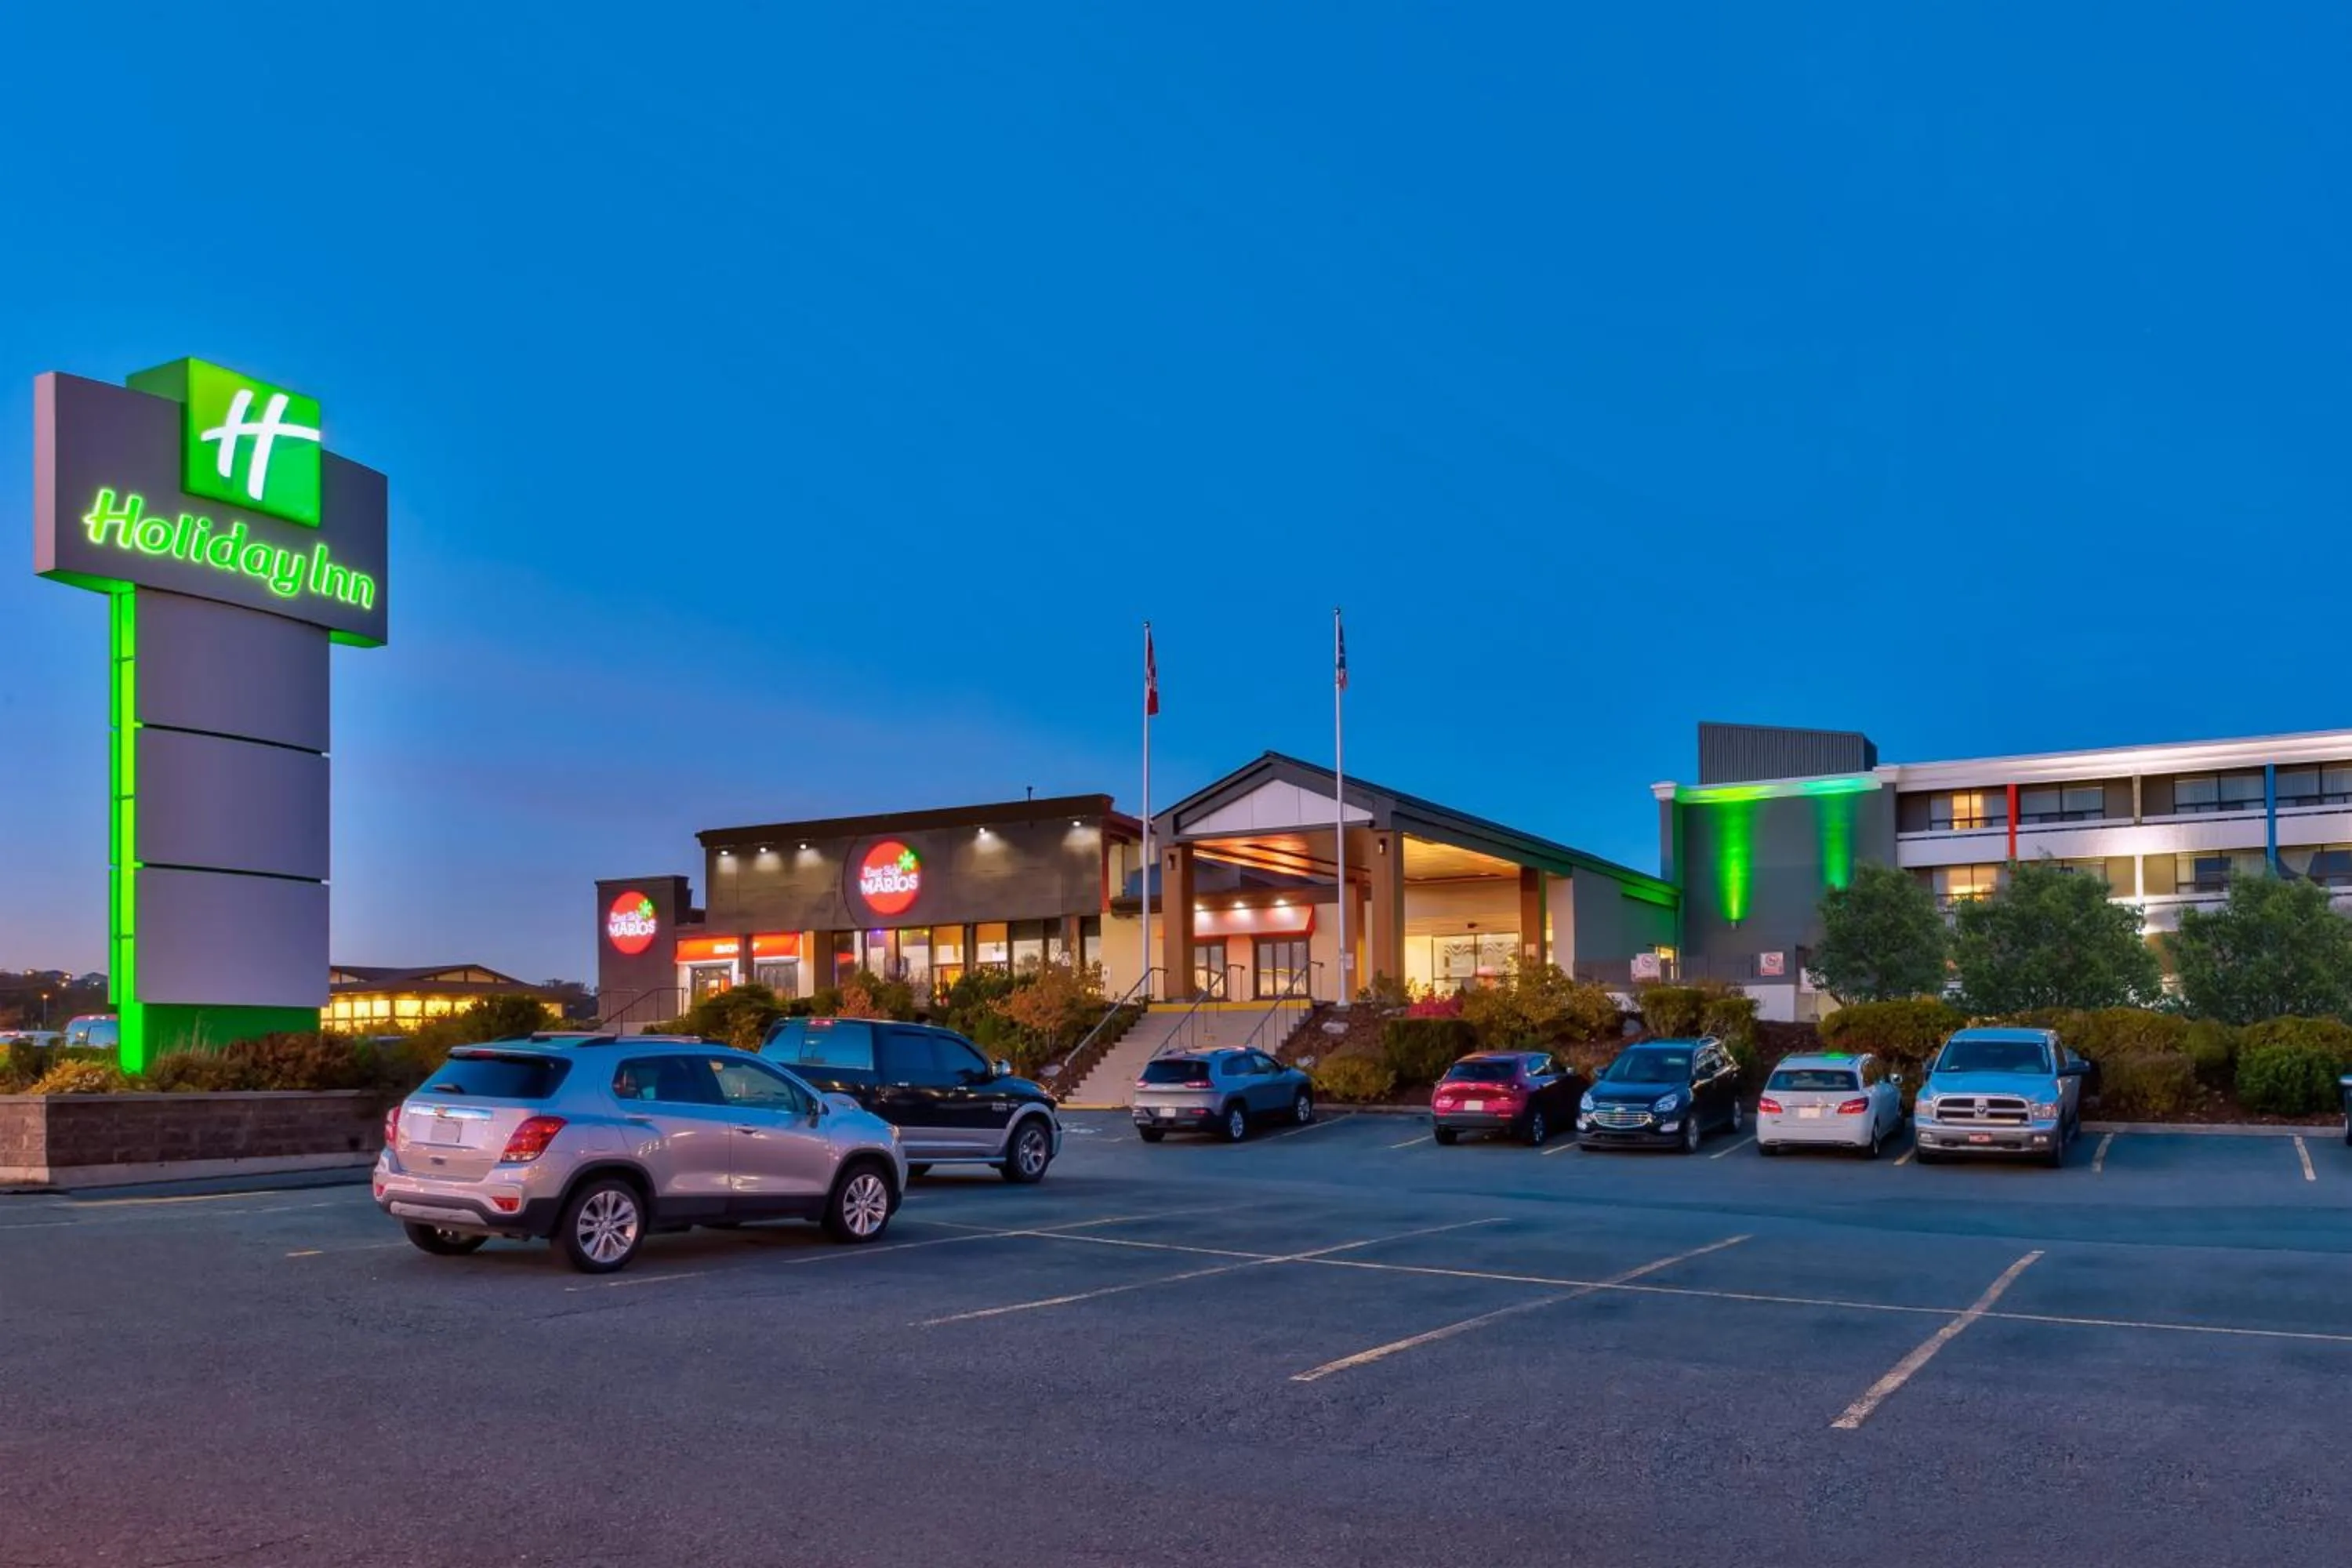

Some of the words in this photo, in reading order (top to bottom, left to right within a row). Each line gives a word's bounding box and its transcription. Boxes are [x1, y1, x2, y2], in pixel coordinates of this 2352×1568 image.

[201, 389, 320, 501] H
[83, 488, 306, 596] Holiday
[309, 543, 376, 609] Inn
